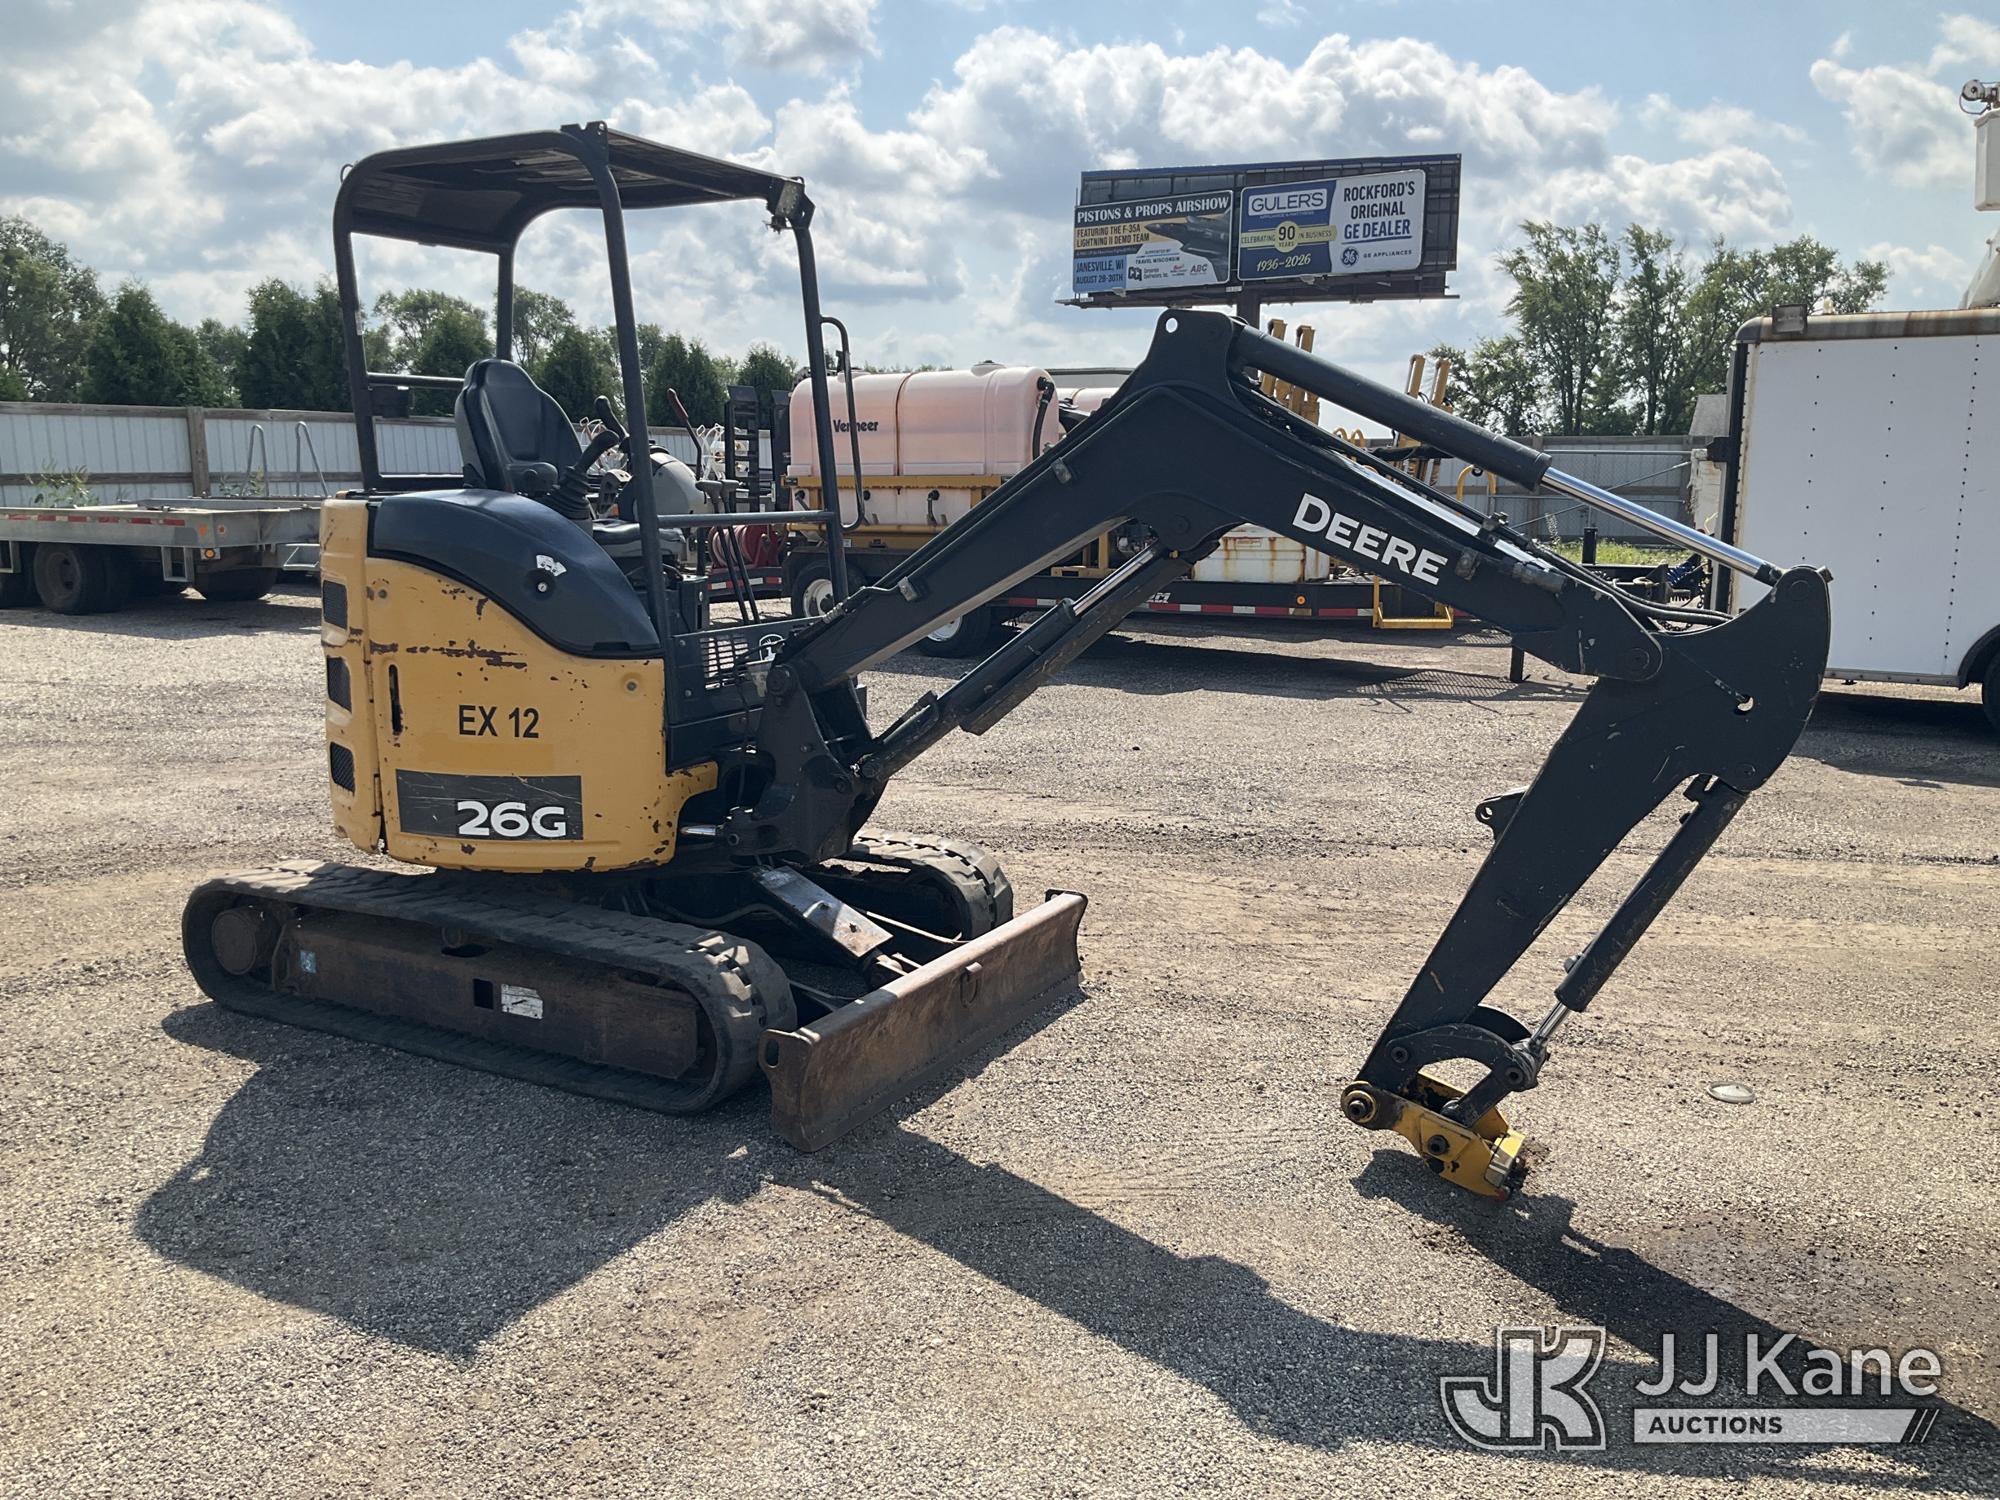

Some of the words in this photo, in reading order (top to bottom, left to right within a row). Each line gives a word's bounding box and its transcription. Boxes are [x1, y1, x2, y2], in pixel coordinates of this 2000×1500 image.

[1343, 181, 1415, 202] ROCKFORD'S
[1077, 207, 1121, 224] PISTONS
[1123, 206, 1133, 218] &
[1135, 202, 1173, 217] PROPS
[1175, 196, 1230, 213] AIRSHOW
[1350, 200, 1406, 220] ORIGINAL
[1077, 227, 1109, 238] FEATURING
[1110, 225, 1122, 234] THE
[1122, 224, 1141, 234] F-35A
[1278, 225, 1296, 241] 90
[1305, 230, 1332, 239] BUSINESS
[1344, 224, 1360, 239] GE
[1362, 219, 1411, 238] DEALER
[1077, 237, 1108, 248] LIGHTNING
[1114, 234, 1132, 244] DEMO
[1132, 232, 1150, 242] TEAM
[1240, 234, 1276, 244] CELEBRATING
[1373, 249, 1412, 258] APPLIANCES
[1115, 259, 1124, 270] WI
[1076, 275, 1098, 284] AUGUST
[1291, 492, 1449, 586] DEERE
[458, 704, 498, 737] EX
[508, 707, 539, 738] 12
[456, 800, 567, 838] 26G
